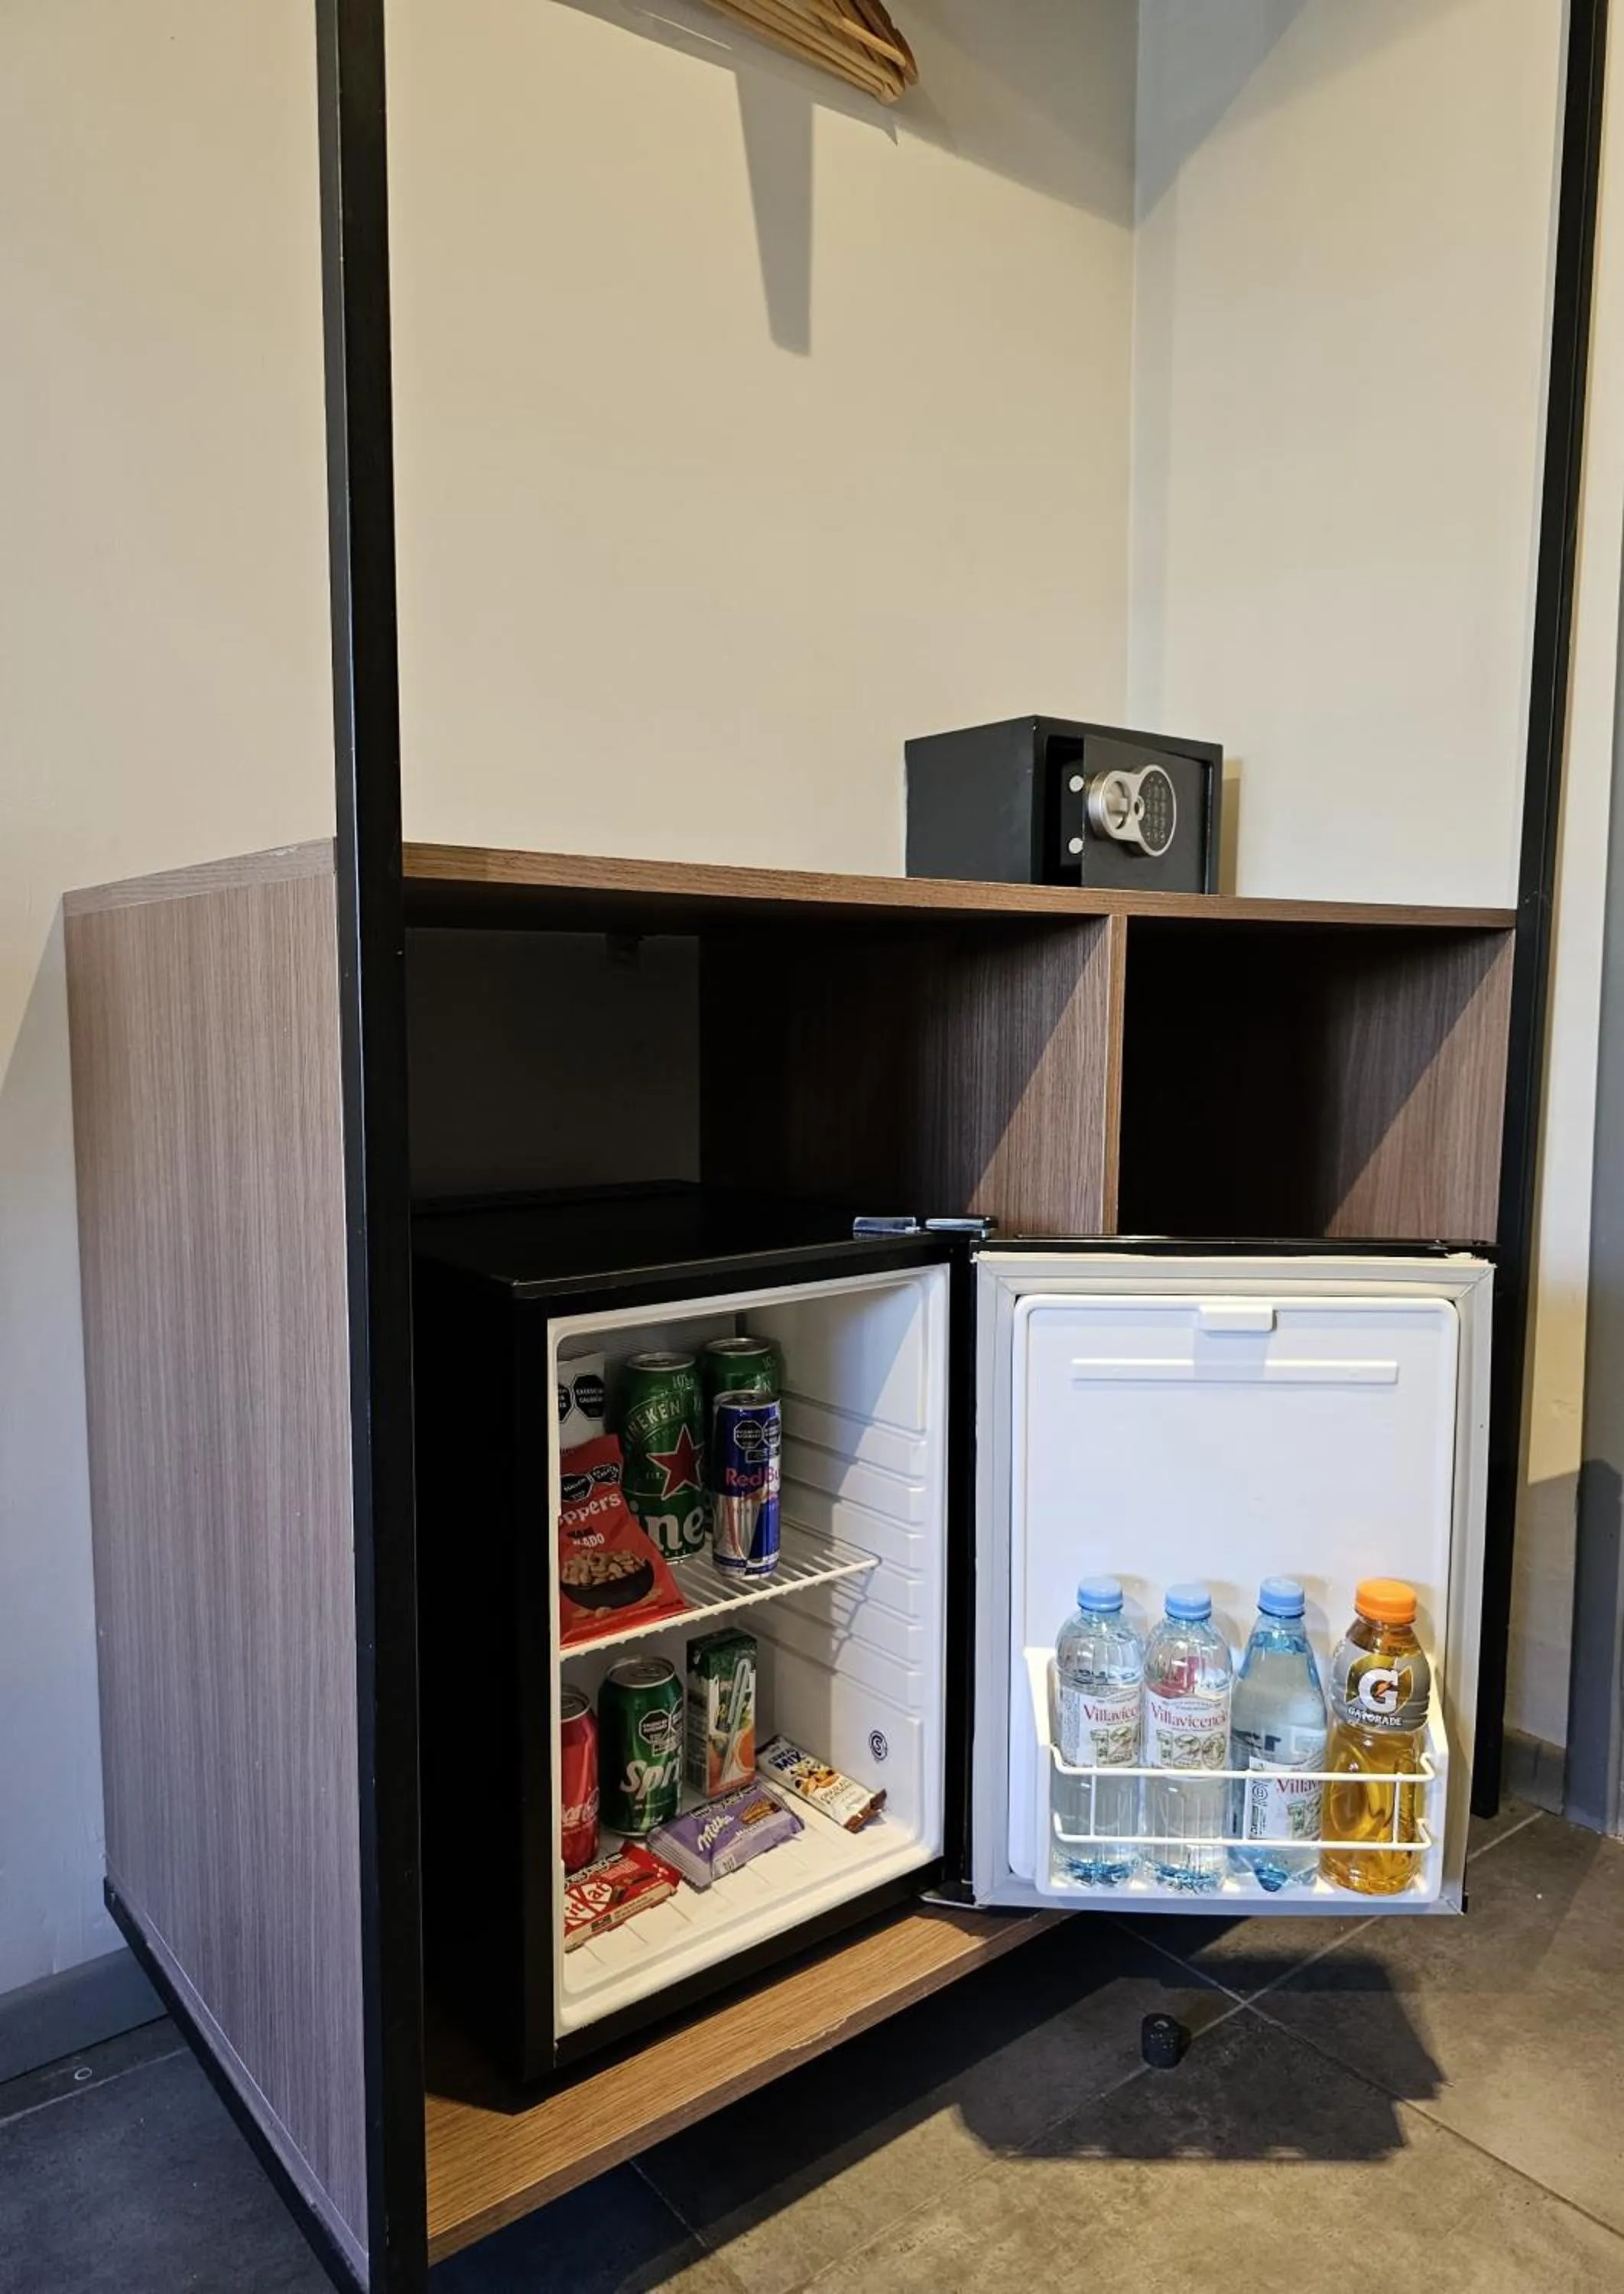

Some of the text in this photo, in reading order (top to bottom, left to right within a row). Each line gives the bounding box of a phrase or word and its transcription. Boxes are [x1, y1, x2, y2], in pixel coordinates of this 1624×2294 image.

[726, 1467, 762, 1487] Red
[1359, 1669, 1398, 1713] G
[1348, 1706, 1402, 1726] GATORADE
[697, 1815, 734, 1851] Milka
